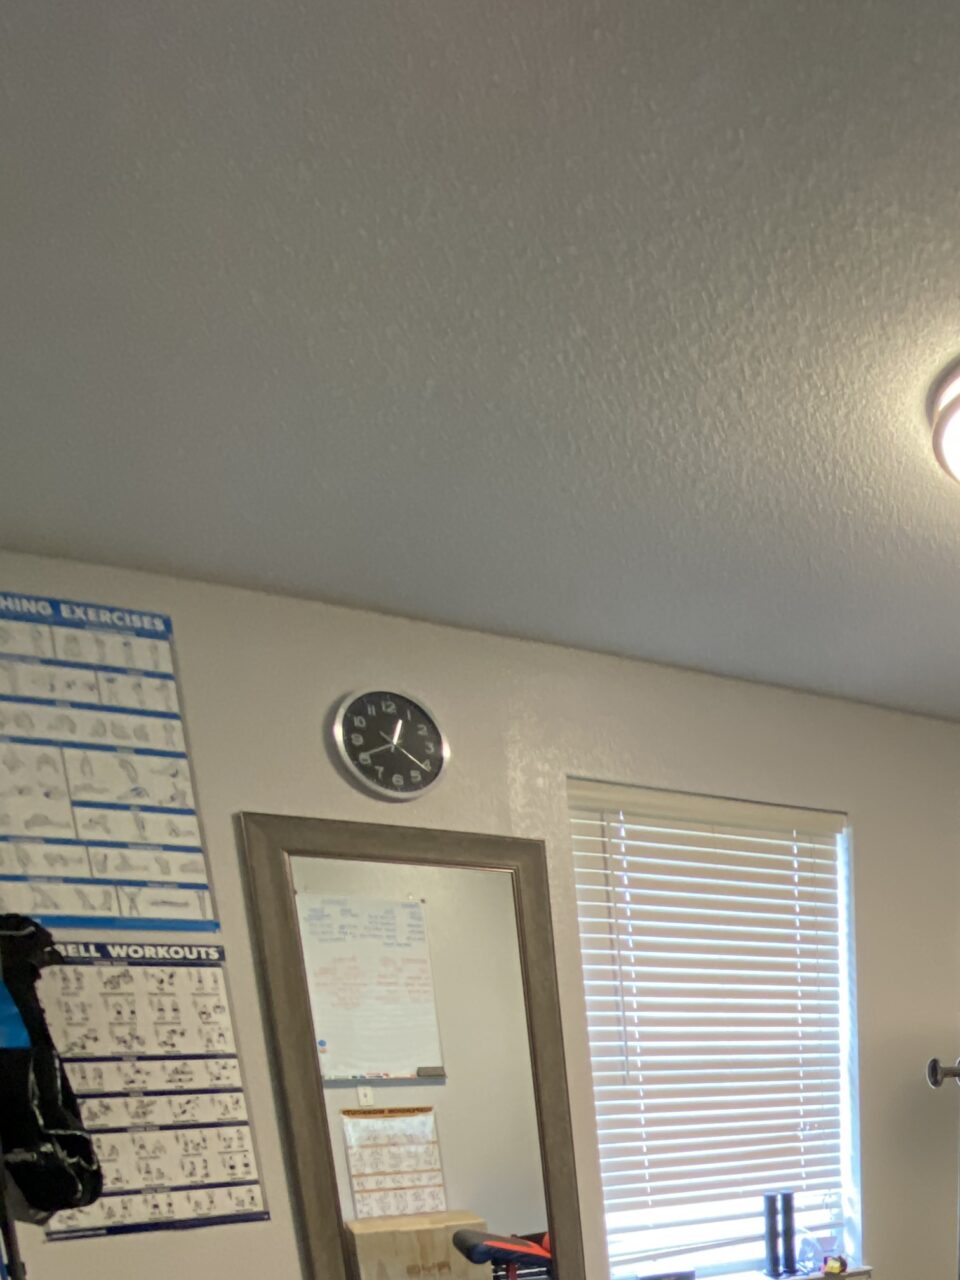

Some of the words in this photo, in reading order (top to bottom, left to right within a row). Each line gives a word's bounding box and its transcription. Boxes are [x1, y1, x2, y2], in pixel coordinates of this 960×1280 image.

[60, 604, 166, 631] EXERCISES
[367, 704, 376, 716] 11
[381, 701, 397, 714] 12
[353, 715, 366, 728] 10
[417, 724, 428, 736] 2
[351, 733, 364, 746] 9
[424, 741, 435, 754] 3
[359, 752, 371, 765] 8
[421, 759, 432, 771] 4
[374, 765, 385, 780] 7
[410, 770, 422, 783] 5
[391, 773, 404, 786] 6
[106, 944, 220, 961] WORKOUTS
